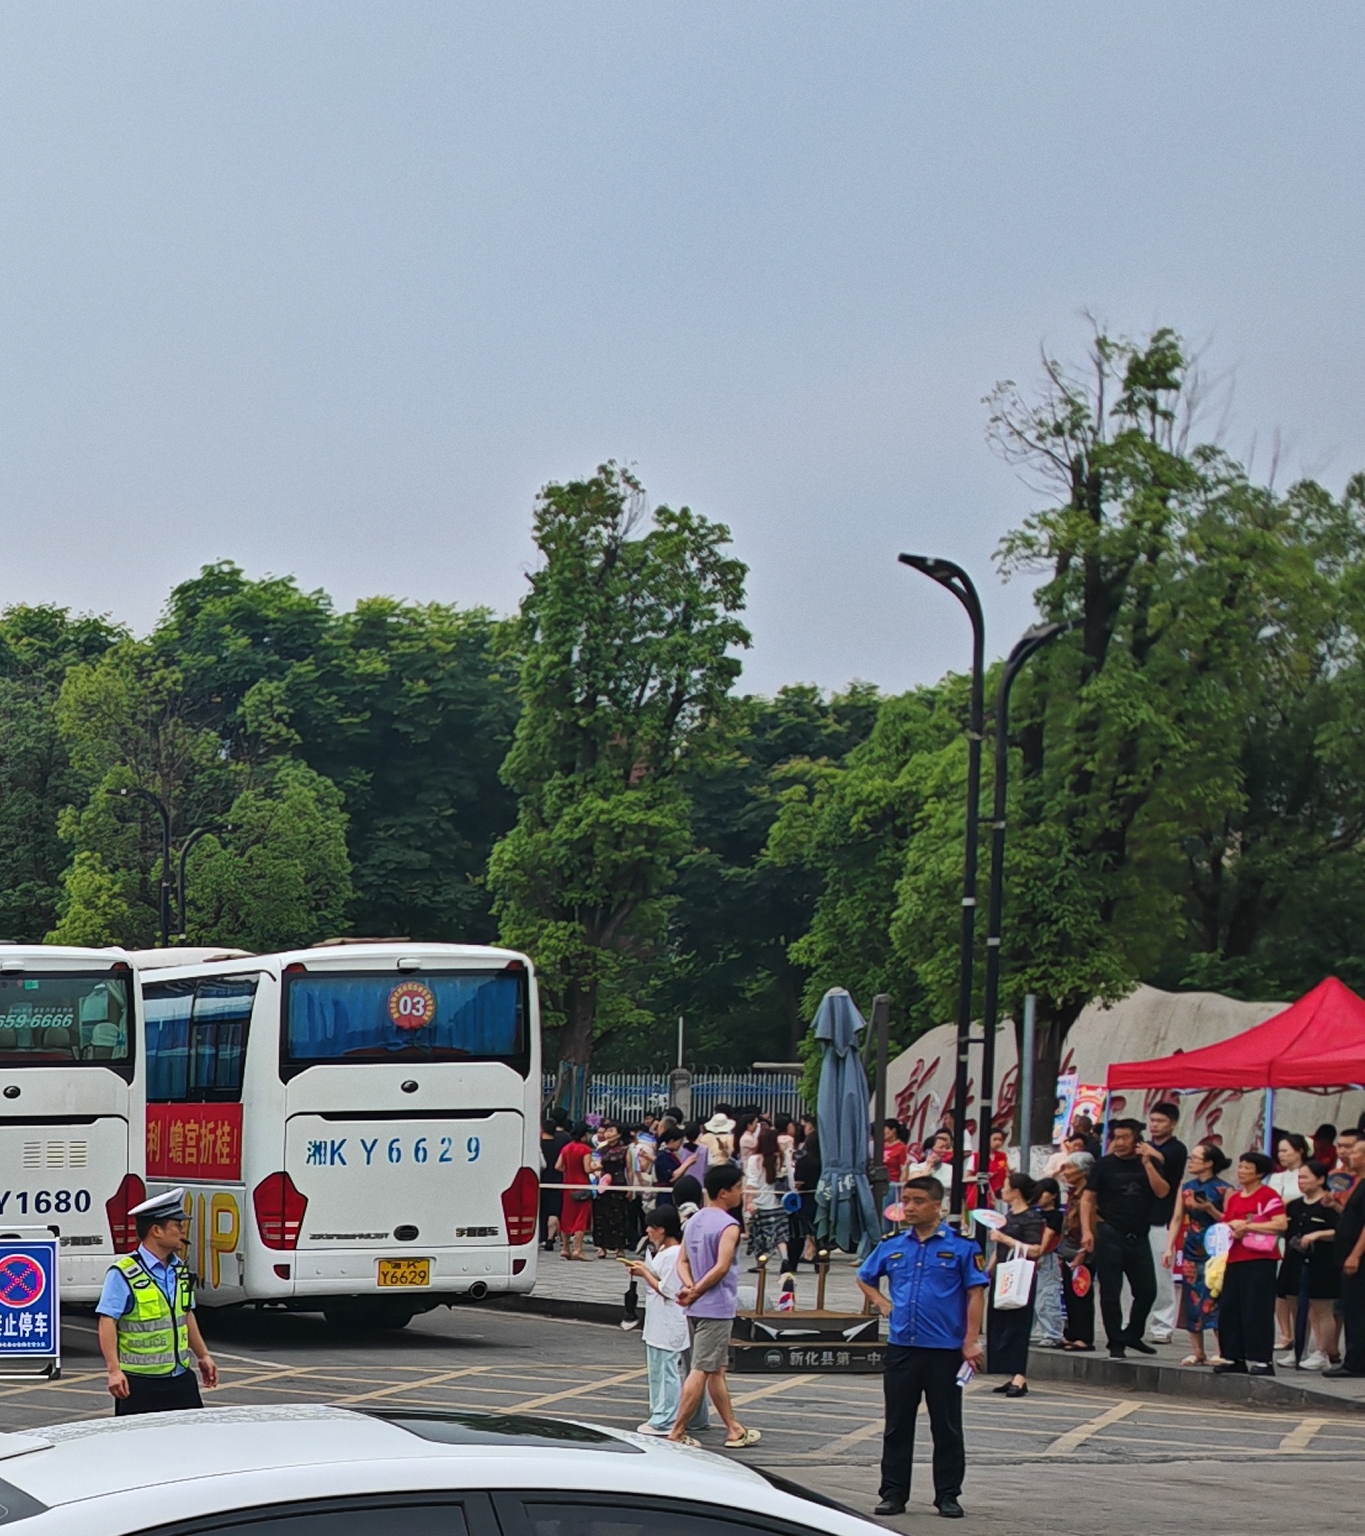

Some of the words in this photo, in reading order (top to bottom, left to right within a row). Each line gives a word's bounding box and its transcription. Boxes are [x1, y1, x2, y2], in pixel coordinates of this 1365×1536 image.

[399, 995, 425, 1016] 03
[306, 1136, 481, 1166] 湘KY6629
[381, 1270, 428, 1285] Y6629
[789, 1351, 886, 1366] 新化县第一中
